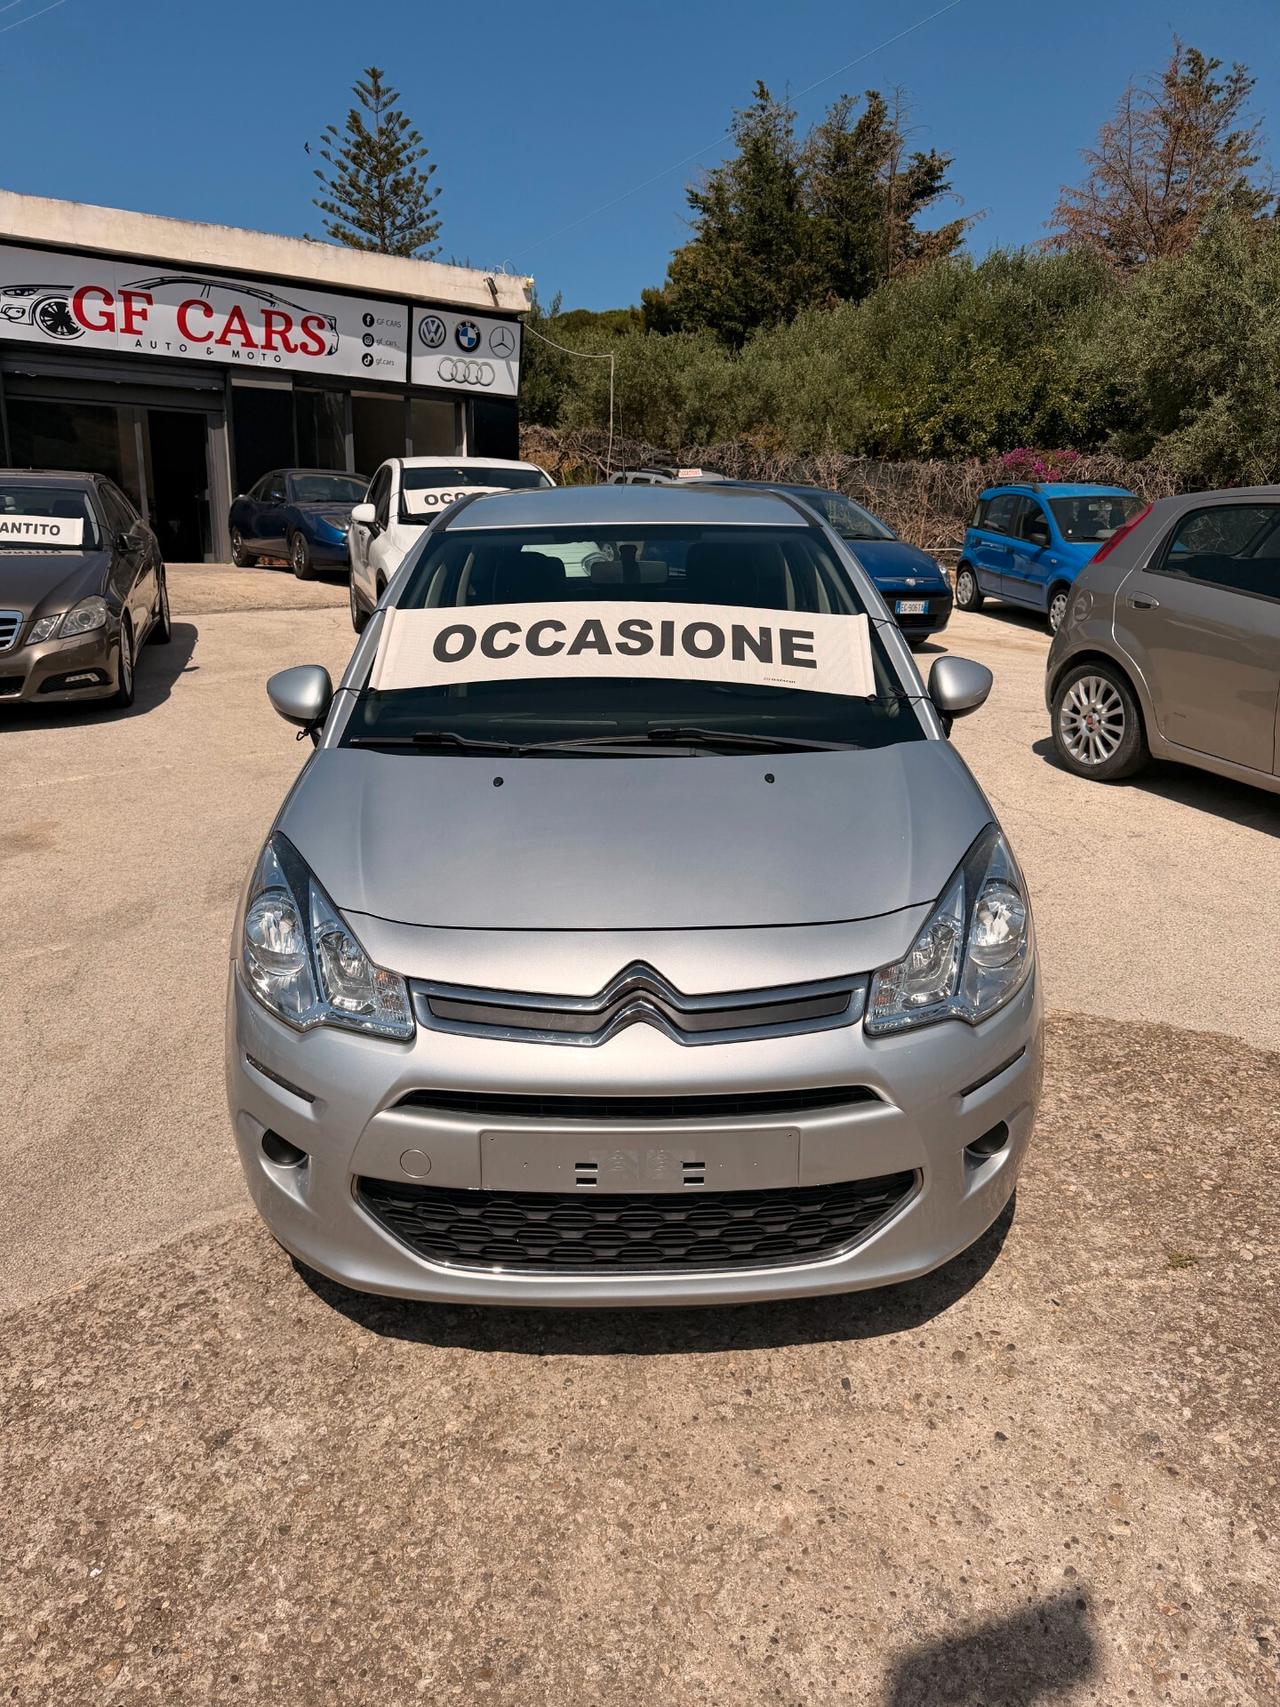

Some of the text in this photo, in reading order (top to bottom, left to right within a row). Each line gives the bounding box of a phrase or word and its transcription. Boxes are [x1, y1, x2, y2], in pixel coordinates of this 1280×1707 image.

[72, 285, 326, 356] GF CARS
[135, 339, 281, 363] AUTO & MOTO
[432, 618, 817, 669] OCCASIONE
